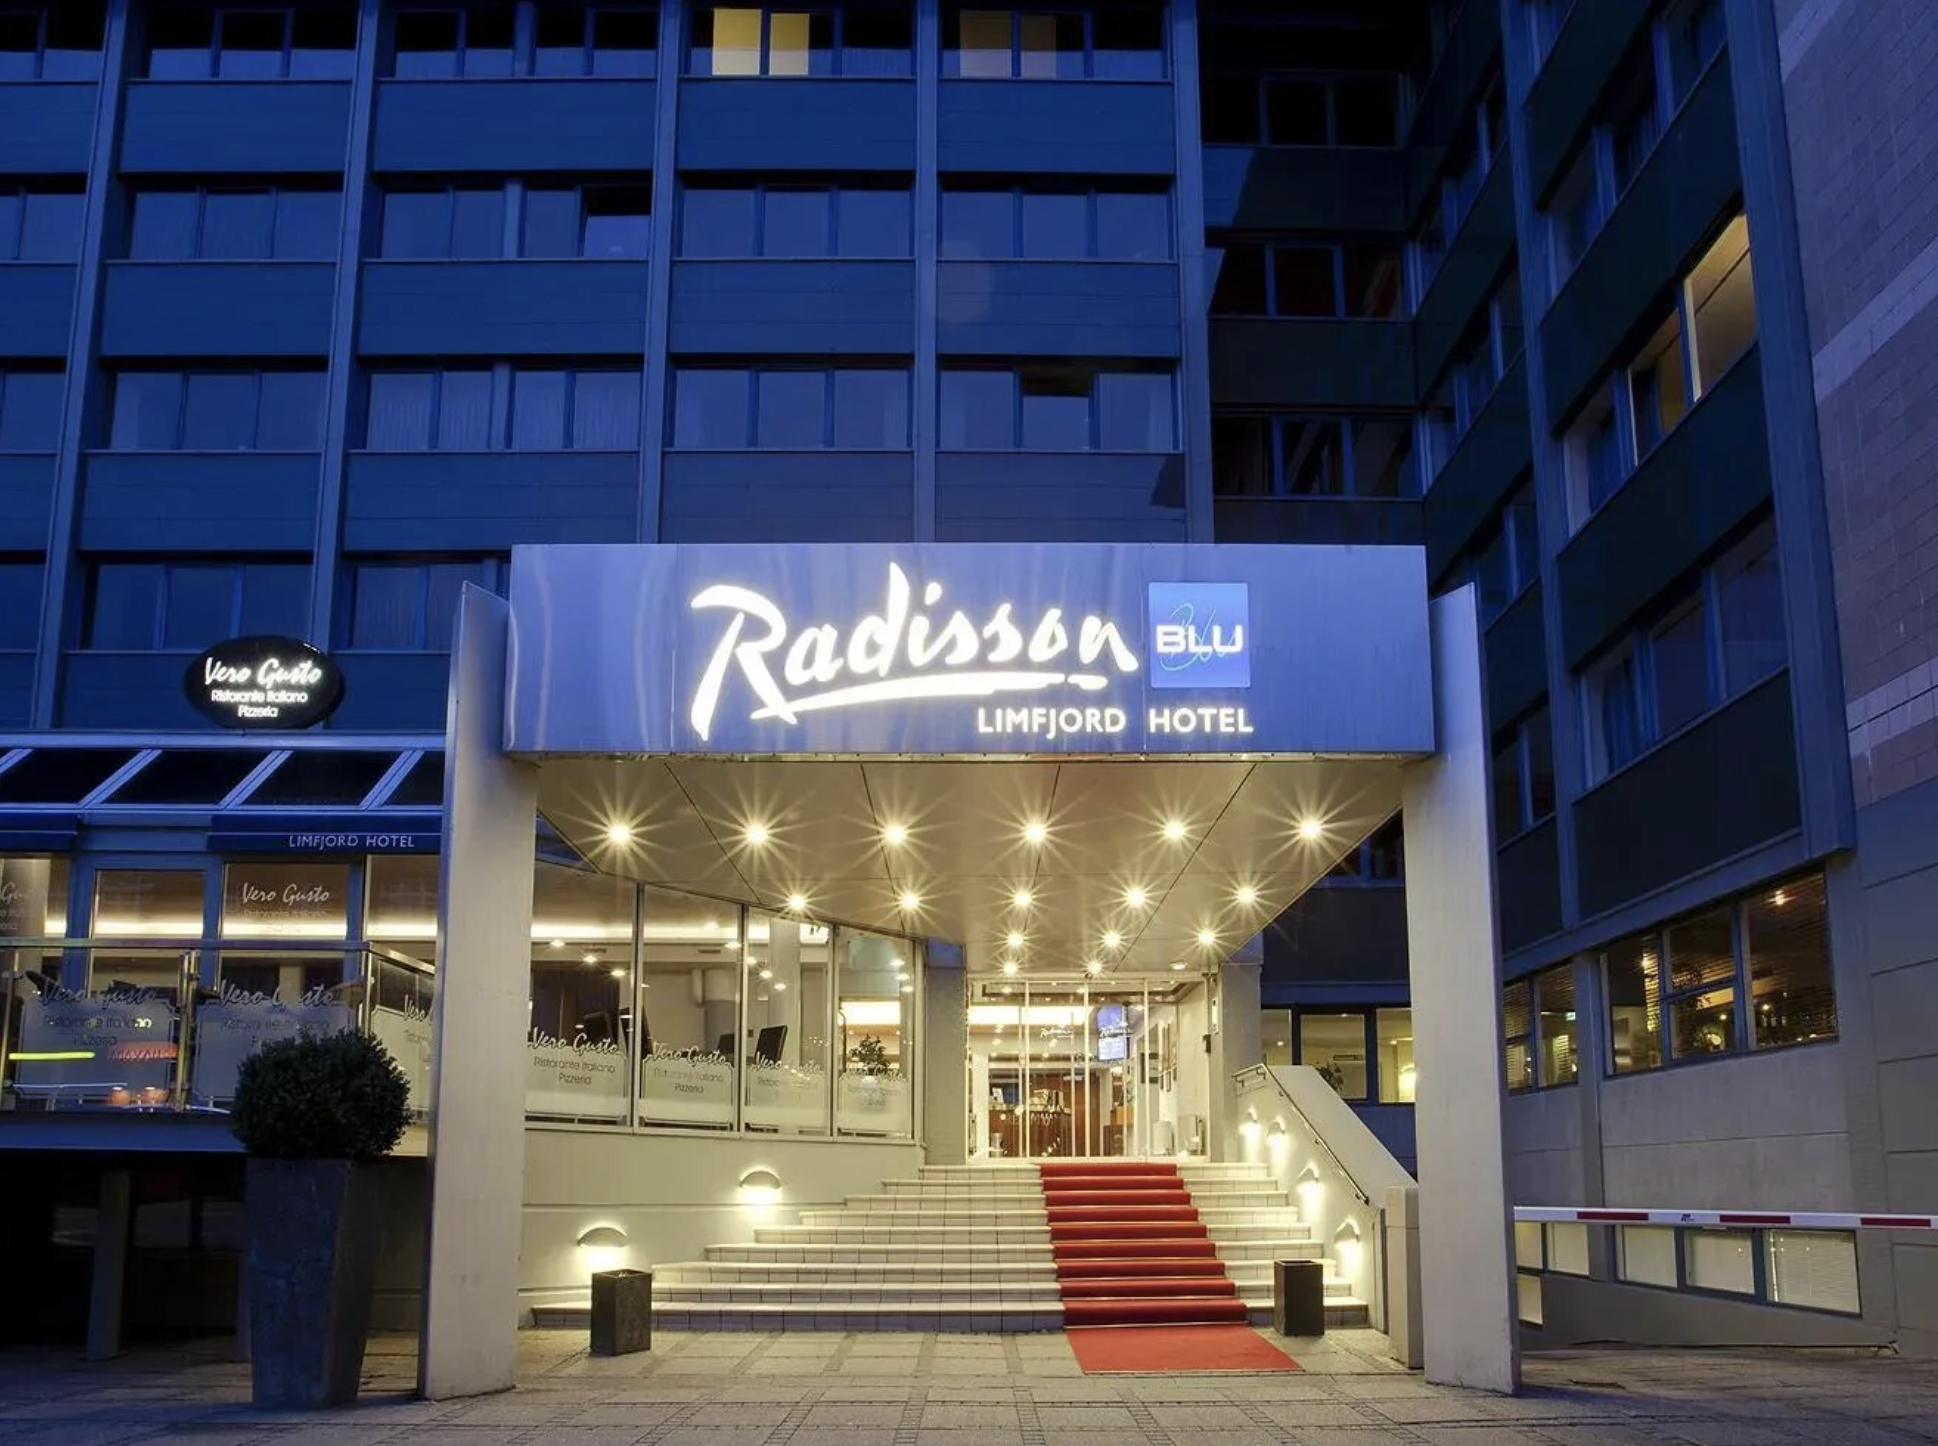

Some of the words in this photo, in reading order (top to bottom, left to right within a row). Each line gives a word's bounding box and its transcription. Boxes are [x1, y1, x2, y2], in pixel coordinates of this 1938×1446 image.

[691, 562, 1139, 740] Radisson
[1156, 624, 1243, 653] BLU
[205, 656, 252, 685] Vero
[256, 657, 323, 689] Gusto
[211, 690, 265, 703] Ristorante
[266, 690, 309, 703] Italiano
[237, 704, 279, 718] Pizzeria
[977, 707, 1127, 739] LIMFJORD
[1148, 707, 1254, 733] HOTEL
[288, 835, 360, 850] LIMFJORD
[365, 835, 415, 848] HOTEL
[242, 882, 278, 905] Vero
[282, 883, 331, 907] Gusto
[531, 1026, 568, 1050] Vero
[573, 1032, 619, 1057] Gusto
[533, 1055, 580, 1072] Ristorante
[687, 1045, 727, 1068] Gusto
